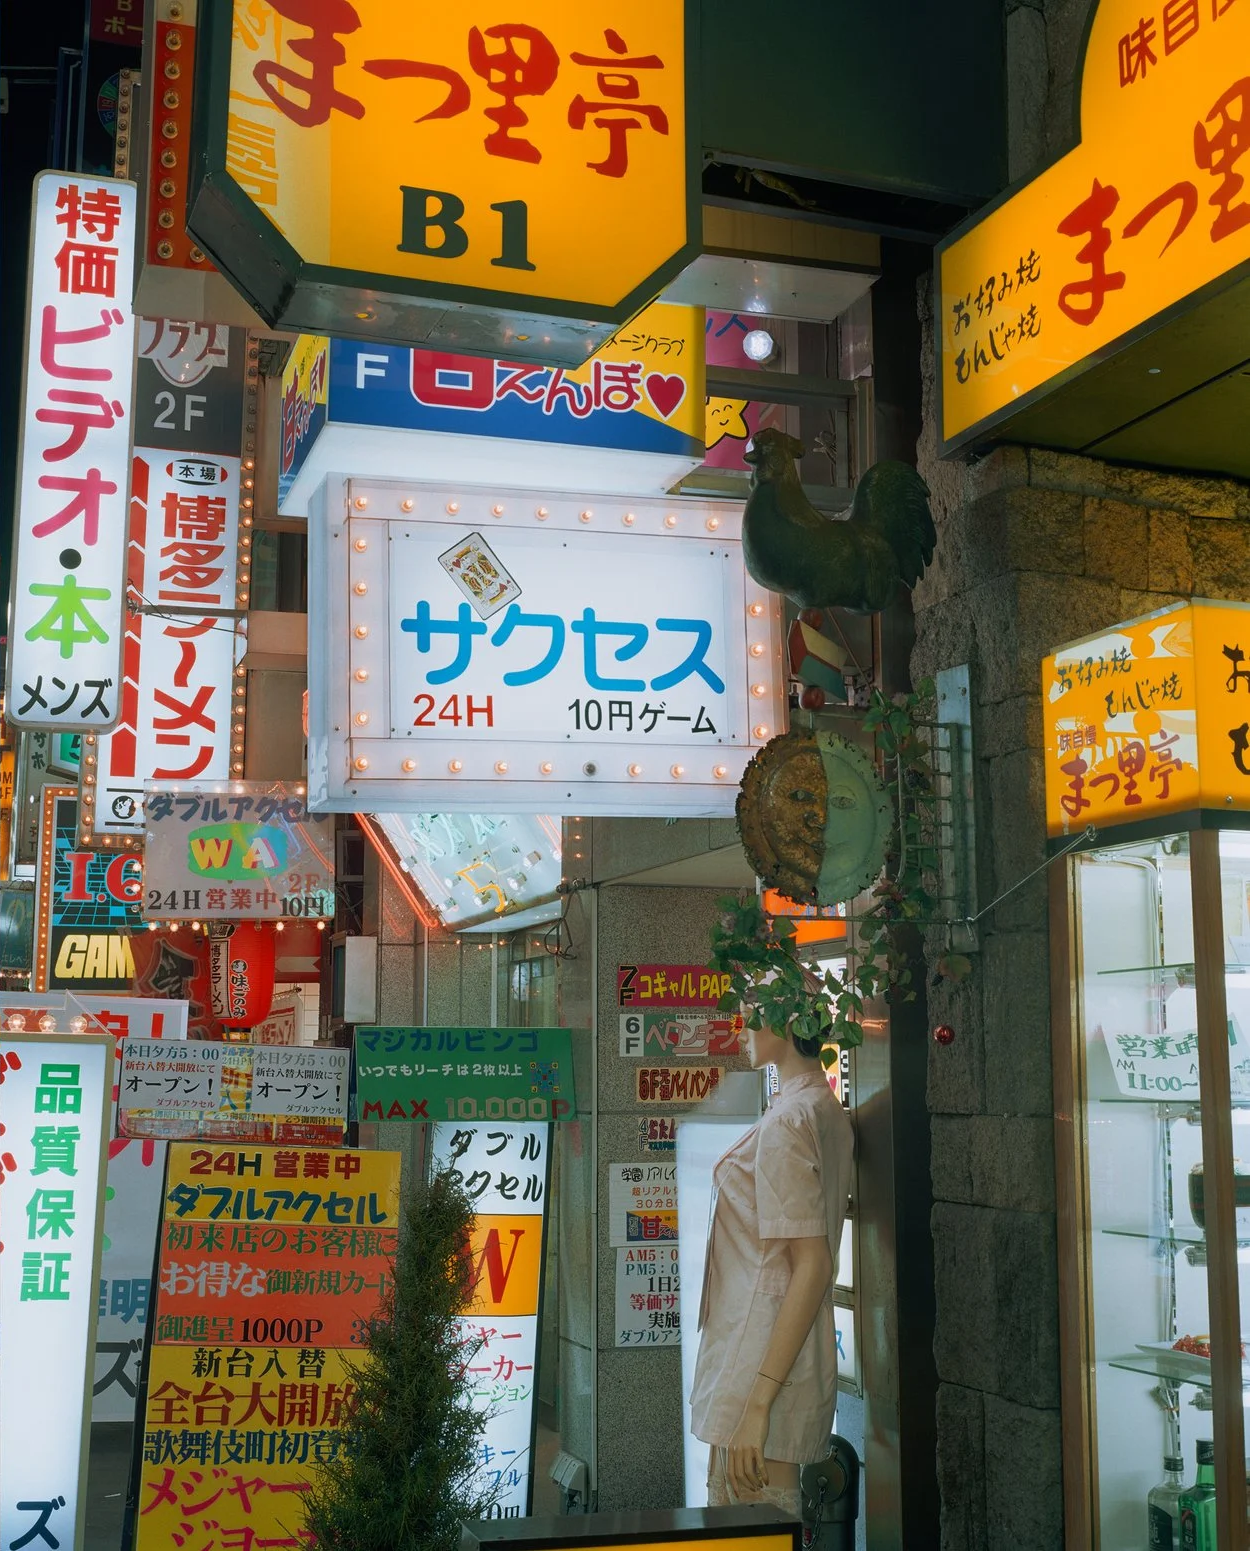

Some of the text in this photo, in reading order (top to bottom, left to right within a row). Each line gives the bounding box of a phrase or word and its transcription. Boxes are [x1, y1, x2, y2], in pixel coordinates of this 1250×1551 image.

[253, 0, 670, 179] まつ里亭
[396, 184, 537, 272] B1
[952, 248, 1041, 337] お好み焼
[954, 303, 1043, 385] もんじゃ焼
[154, 391, 207, 432] 2F
[178, 464, 217, 481] 本場
[152, 491, 227, 780] 博多ラーメン
[400, 600, 726, 695] サクセス
[1057, 644, 1133, 694] お好み焼
[17, 674, 114, 720] メンズ
[413, 694, 718, 735] 24H 10円ゲーム
[1104, 671, 1183, 719] もんじゃ焼
[1060, 729, 1183, 818] まつ里亭
[147, 887, 278, 912] 24H 営業中
[287, 872, 321, 895] 2F
[358, 1030, 540, 1053] マジカルビンゴ
[625, 1016, 641, 1055] 6F
[125, 1075, 214, 1097] オープン！
[358, 1063, 524, 1078] いつでもリーチは2枚以上
[256, 1081, 343, 1103] オープン！
[362, 1099, 430, 1121] MAX
[190, 1148, 363, 1181] 24H 営業中
[450, 1128, 541, 1162] ダブル
[21, 1063, 83, 1302] 品質保証
[167, 1182, 387, 1226] ダブルアクセル
[158, 1315, 324, 1344] 御進呈 1000P
[191, 1347, 327, 1380] 新台入替
[140, 1467, 312, 1518] メジャー
